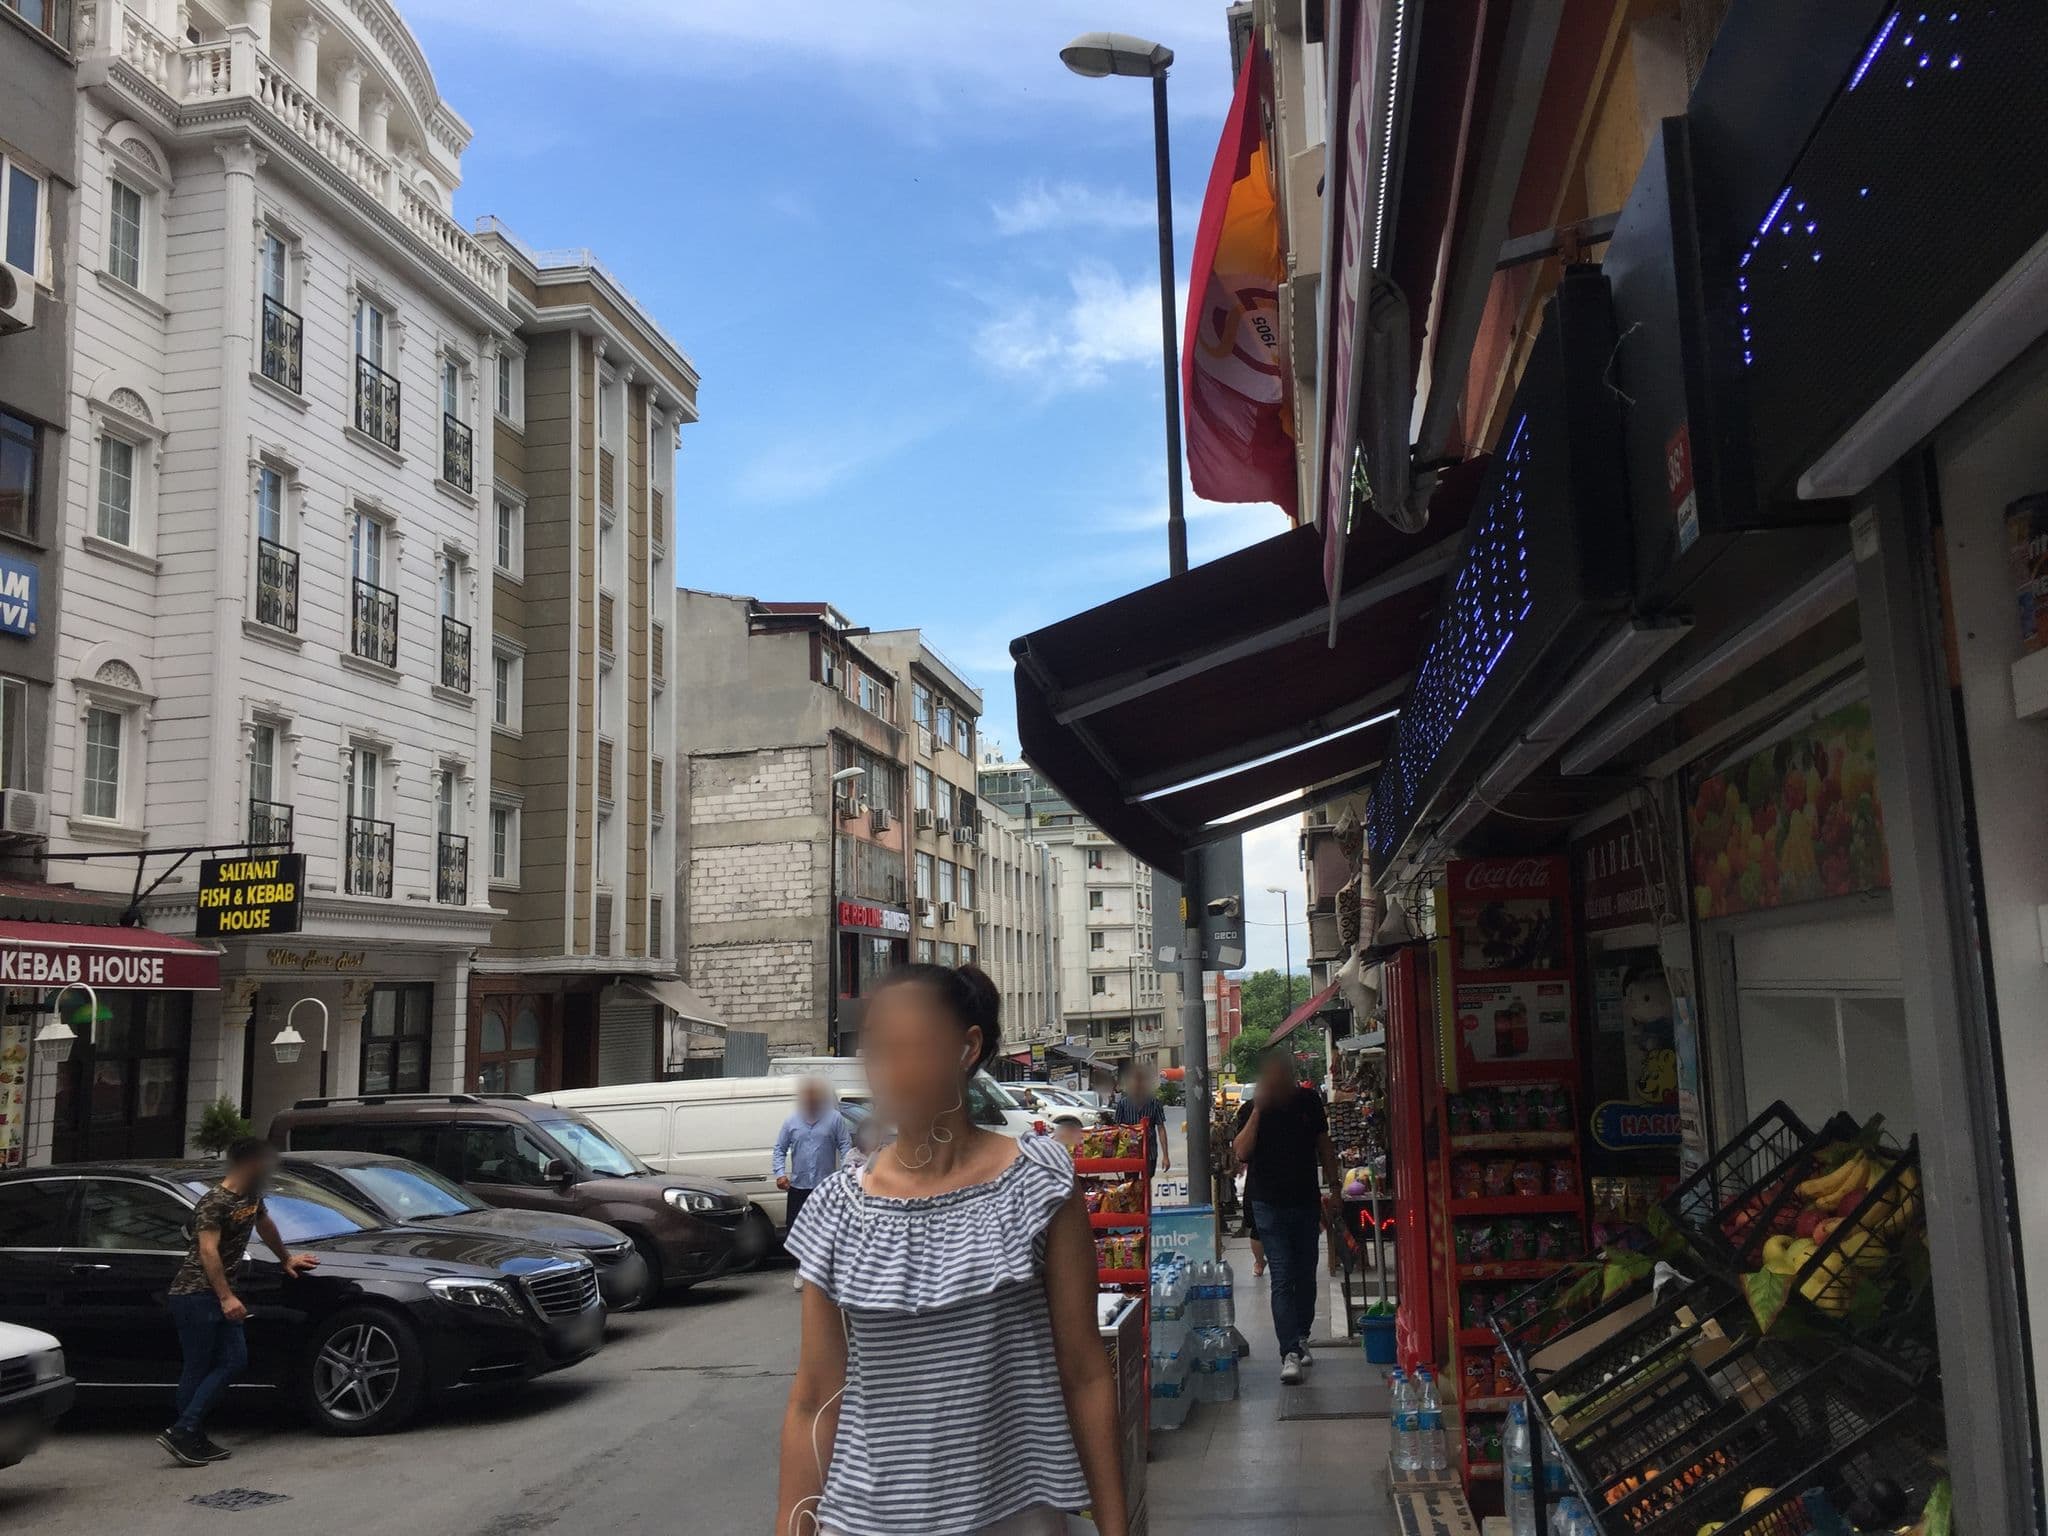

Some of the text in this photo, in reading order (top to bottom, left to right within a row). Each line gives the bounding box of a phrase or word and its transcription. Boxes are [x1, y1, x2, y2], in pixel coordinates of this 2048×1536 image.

[1251, 317, 1277, 348] 1905
[219, 860, 279, 882] SALTANAT
[200, 883, 295, 908] FISH & KEBAB
[219, 908, 271, 931] HOUSE
[0, 950, 165, 985] KEBAB HOUSE
